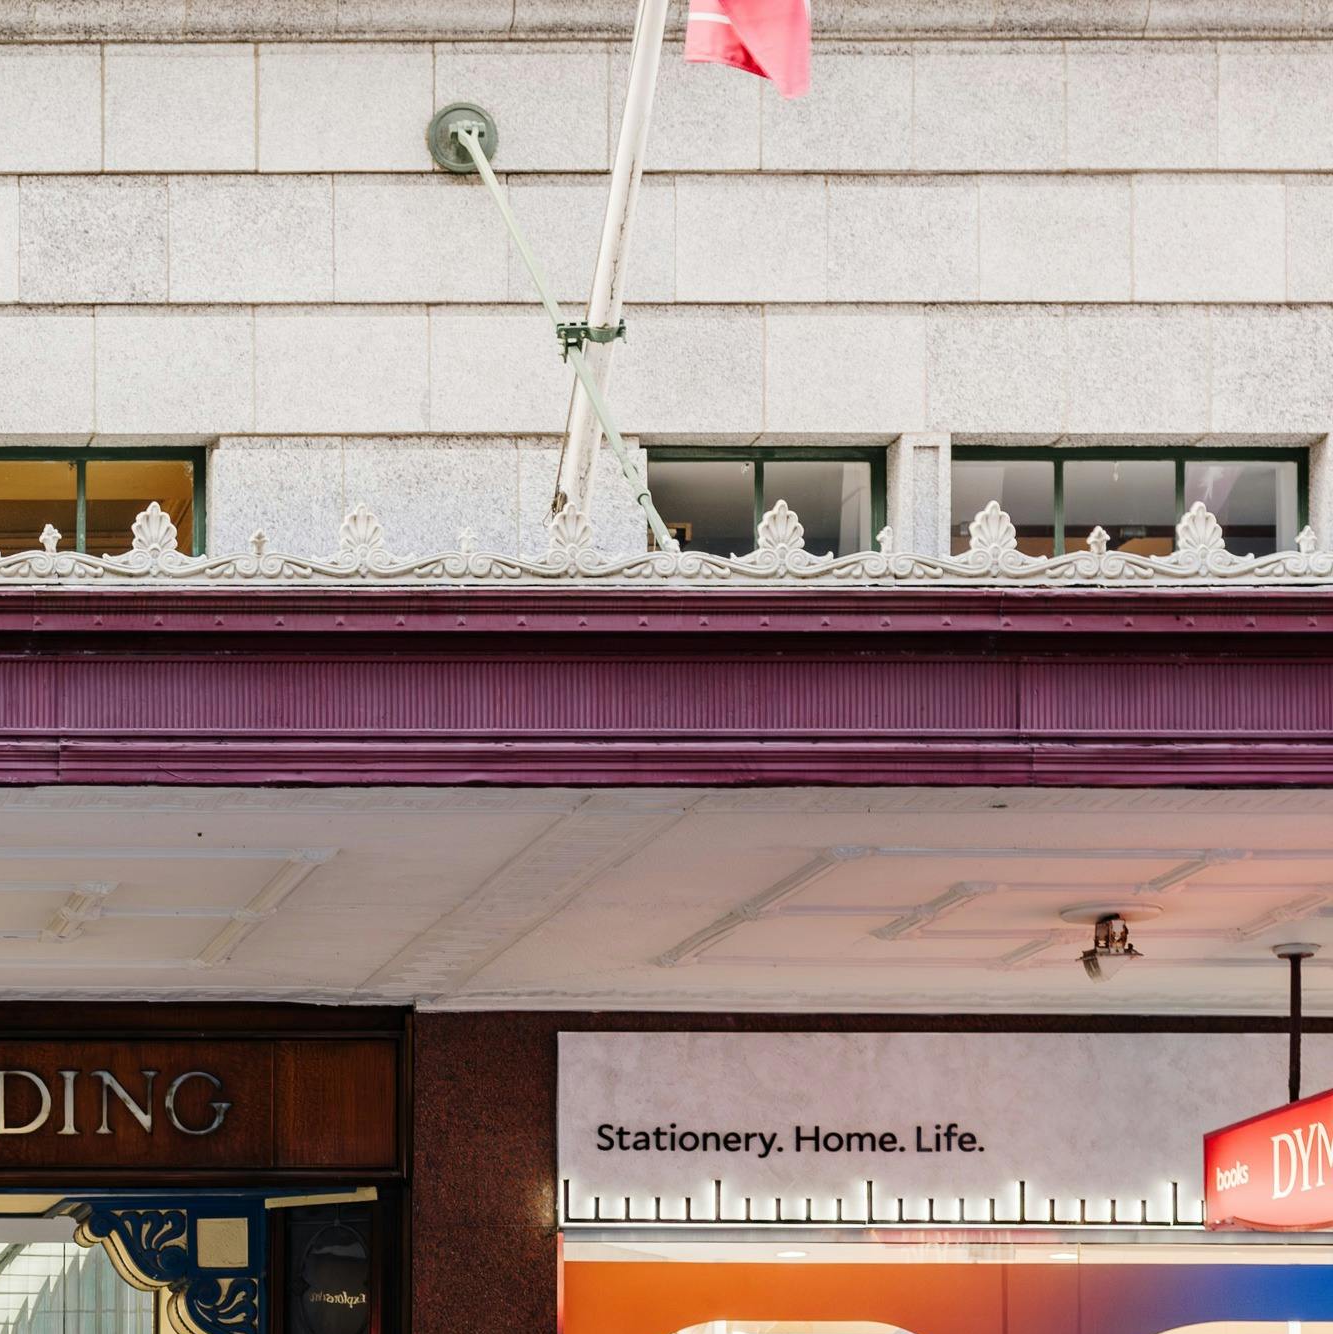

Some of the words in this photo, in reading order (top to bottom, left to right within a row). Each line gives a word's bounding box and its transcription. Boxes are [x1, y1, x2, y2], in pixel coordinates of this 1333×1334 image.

[596, 1123, 784, 1158] Stationery.
[795, 1125, 906, 1153] Home.
[916, 1123, 986, 1153] Life.
[1216, 1160, 1249, 1192] books
